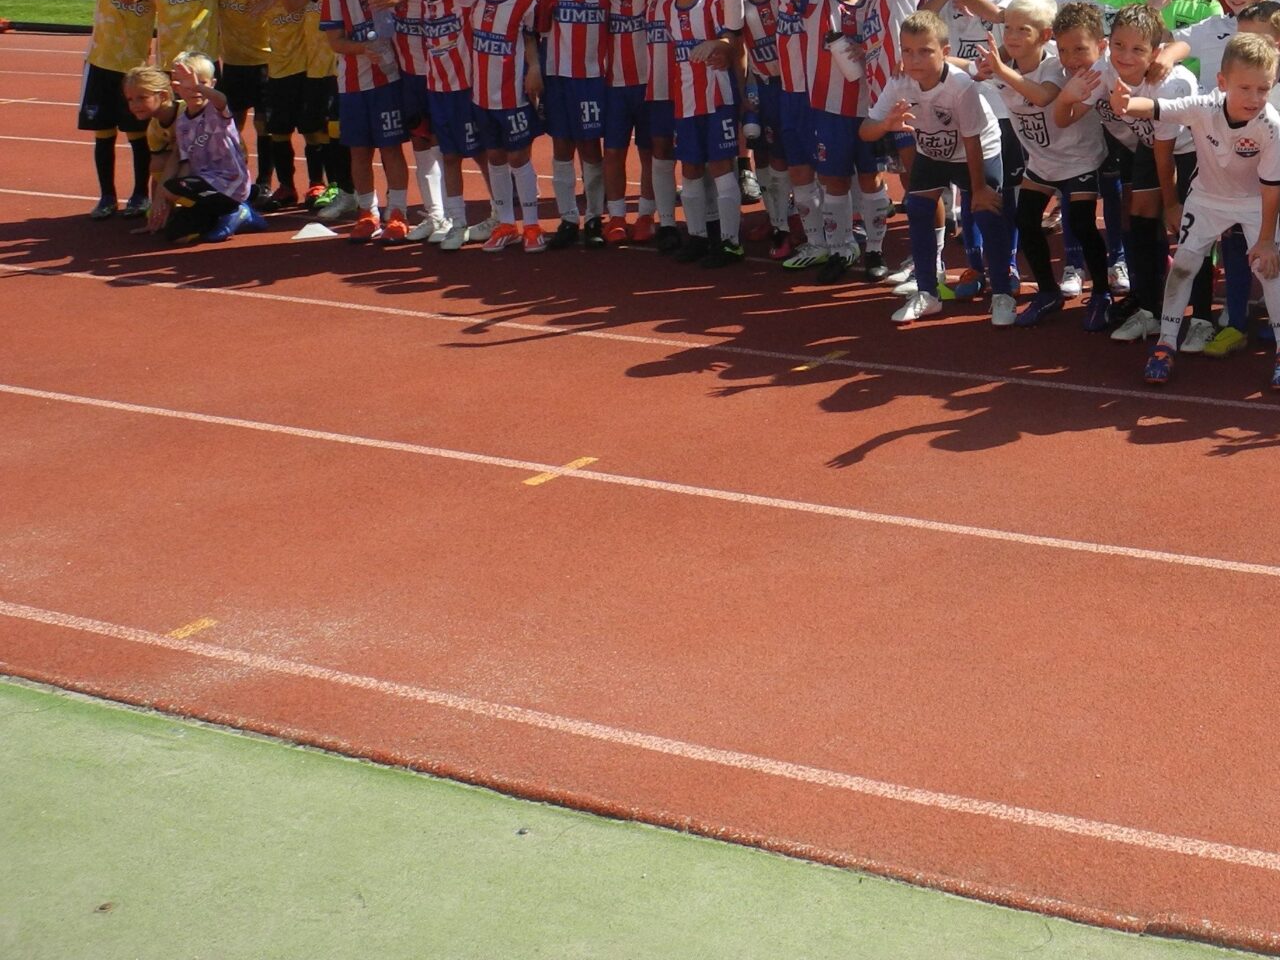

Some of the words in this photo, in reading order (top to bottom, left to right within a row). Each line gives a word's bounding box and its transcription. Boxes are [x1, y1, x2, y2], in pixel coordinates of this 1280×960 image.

[553, 8, 606, 23] UMEN
[380, 109, 403, 131] 32
[722, 118, 736, 140] 5
